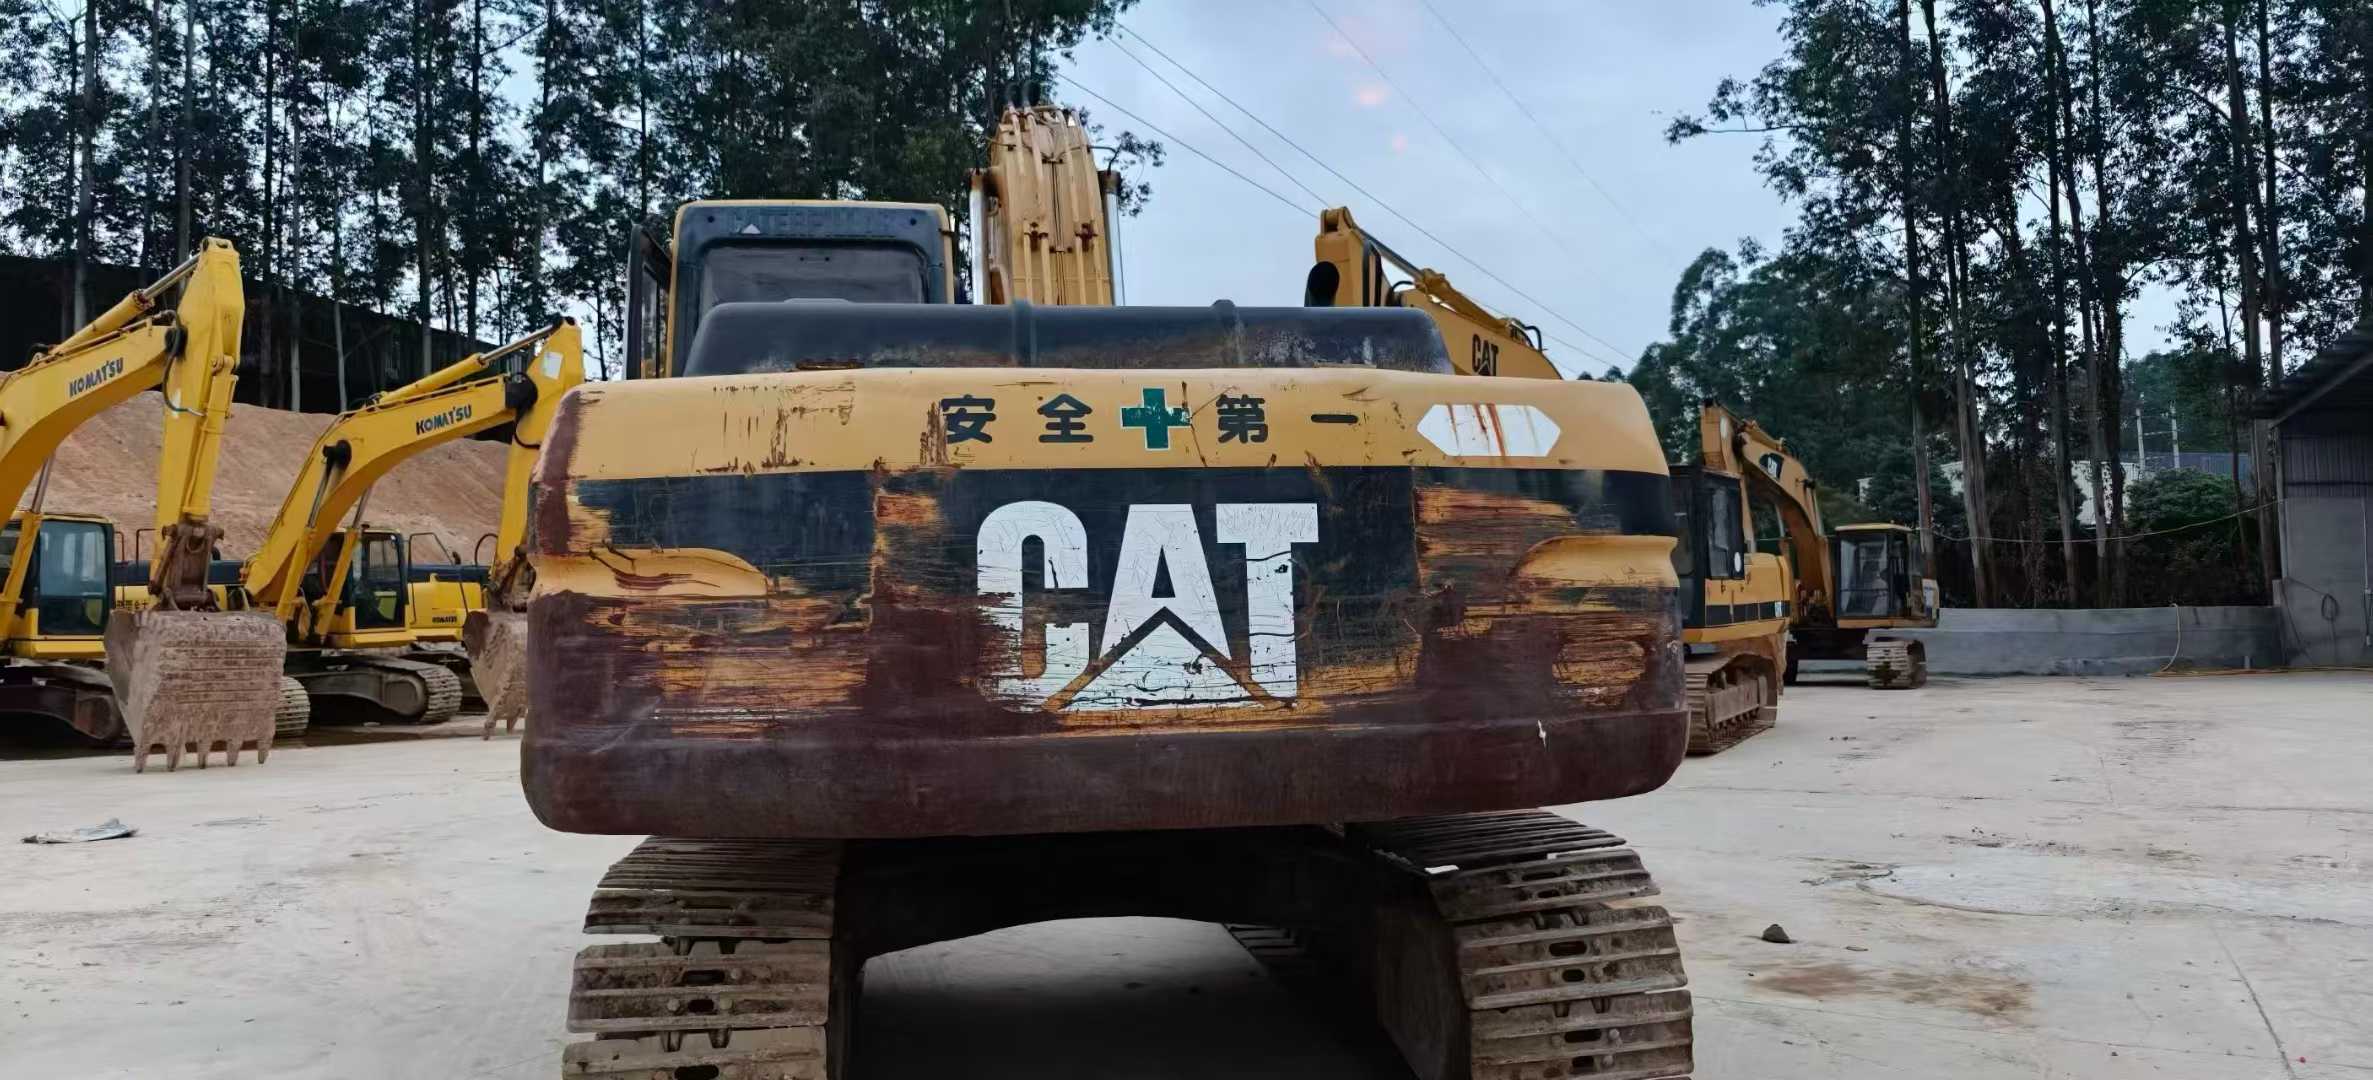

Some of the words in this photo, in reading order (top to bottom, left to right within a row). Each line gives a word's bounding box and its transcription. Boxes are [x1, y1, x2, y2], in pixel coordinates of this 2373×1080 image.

[1472, 333, 1499, 376] CAT
[69, 357, 124, 398] KOMATSU
[416, 404, 472, 435] KOMATSU
[940, 393, 1094, 444] 安全
[1215, 394, 1359, 444] 第一
[977, 500, 1319, 712] CAT
